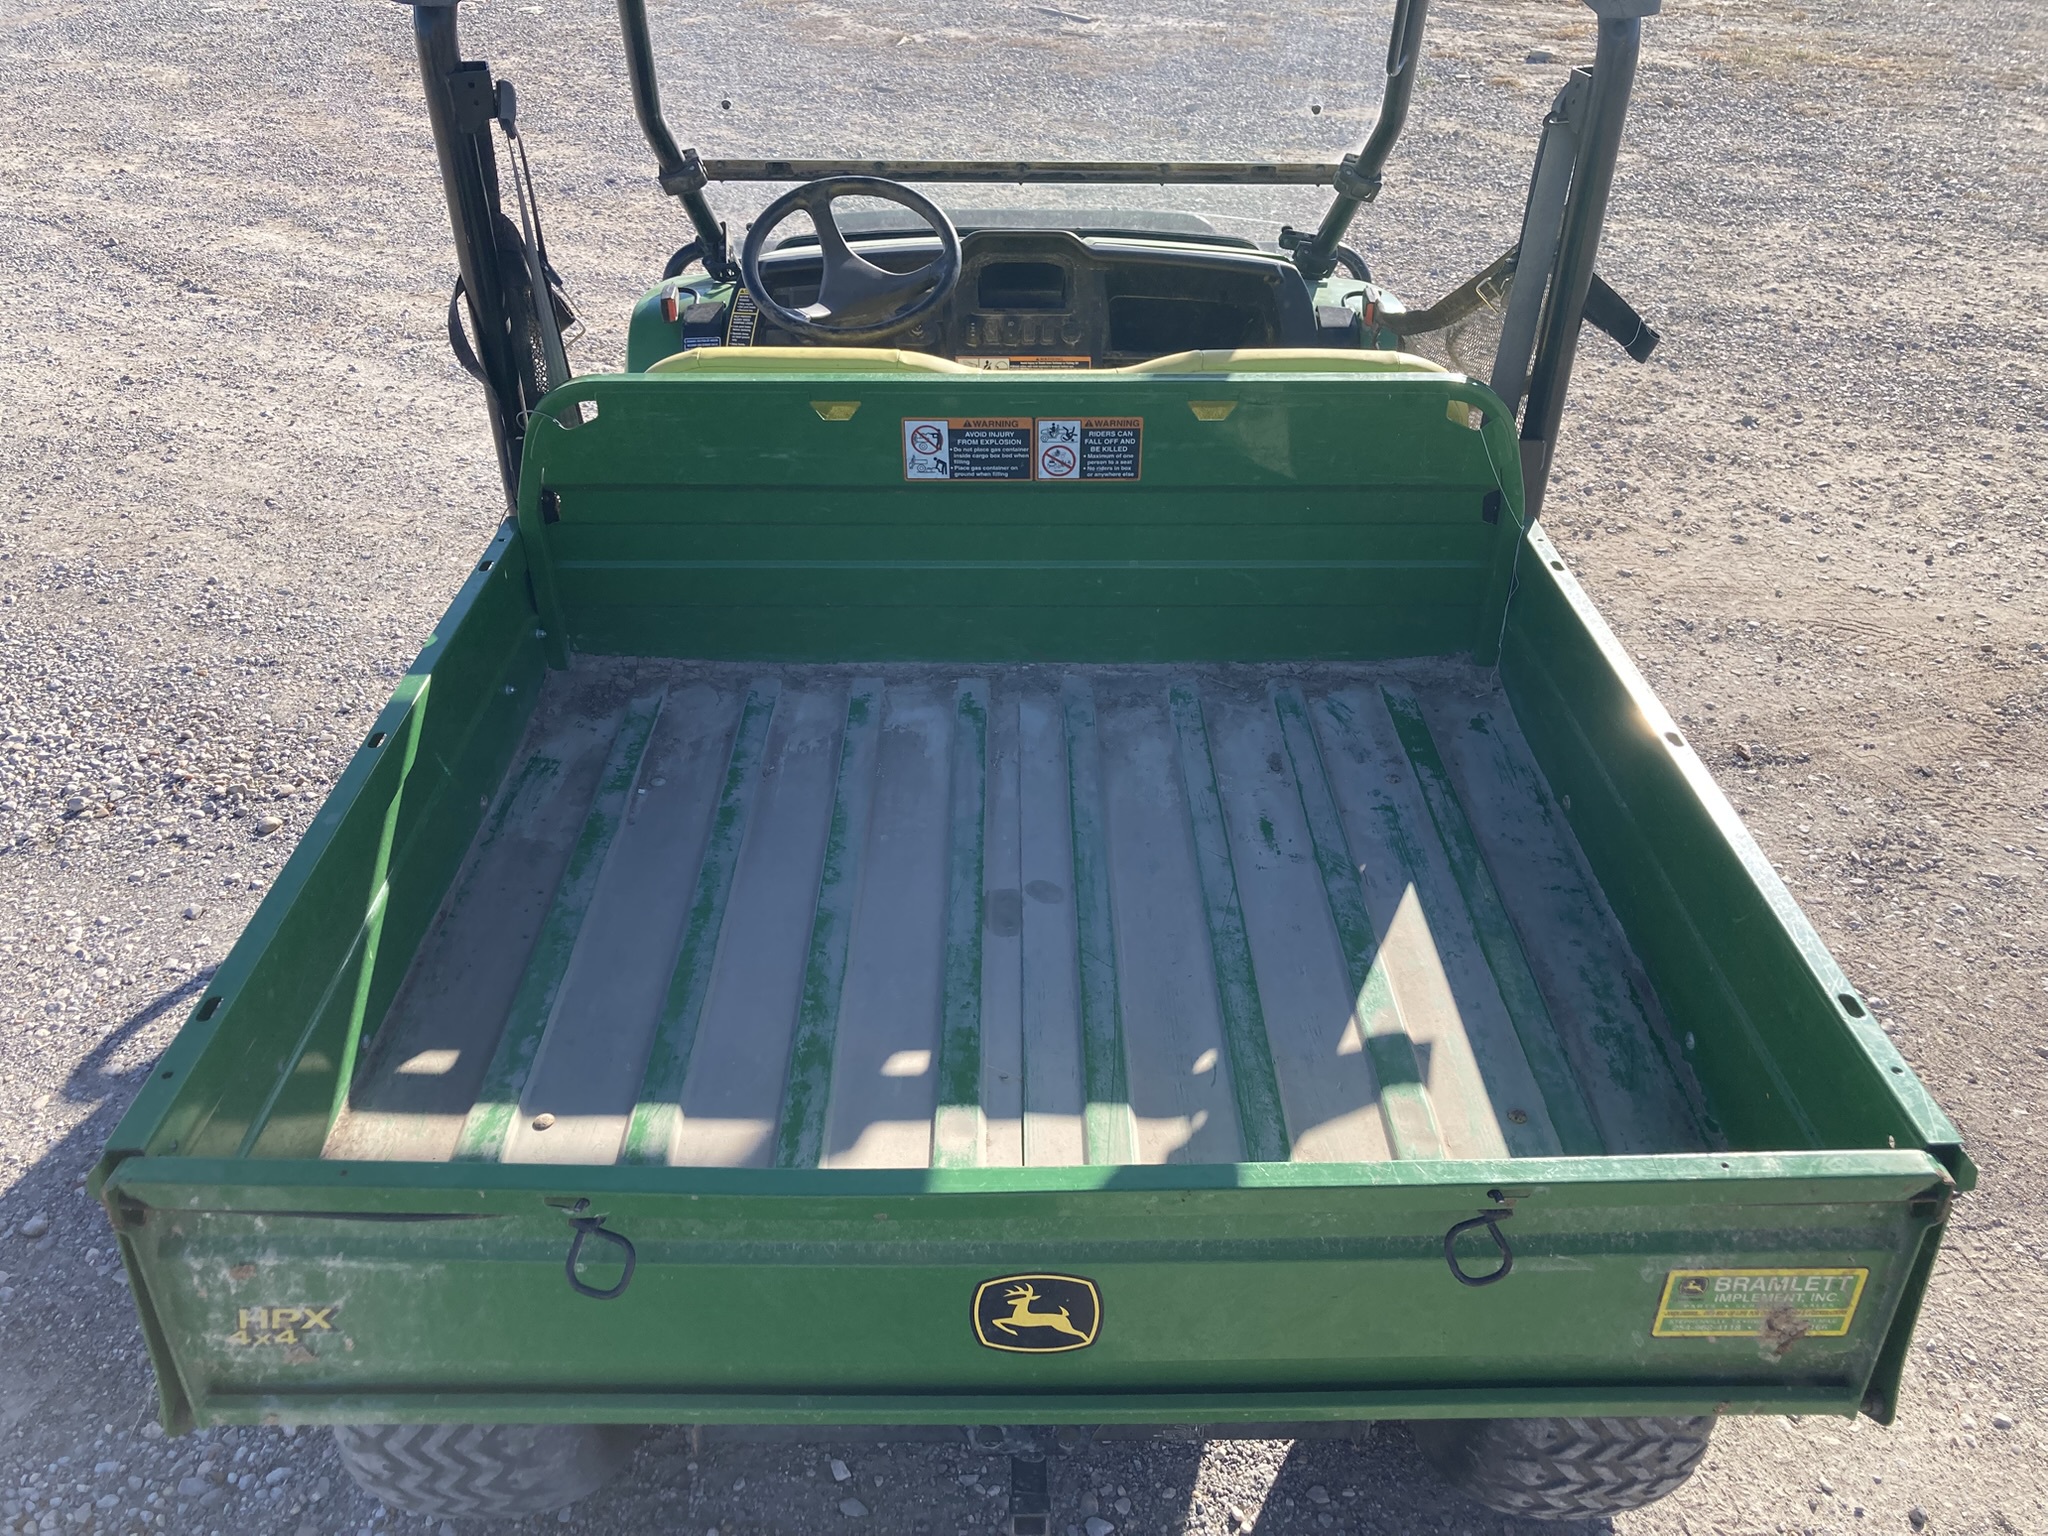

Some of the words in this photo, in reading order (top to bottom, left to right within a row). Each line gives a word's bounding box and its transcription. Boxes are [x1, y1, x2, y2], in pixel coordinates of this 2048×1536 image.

[1714, 1276, 1854, 1292] BRAMLETT
[1714, 1293, 1806, 1303] IMPLEMENT,
[1810, 1292, 1840, 1302] INC.
[239, 1308, 332, 1329] HPX
[226, 1330, 298, 1345] 4x4
